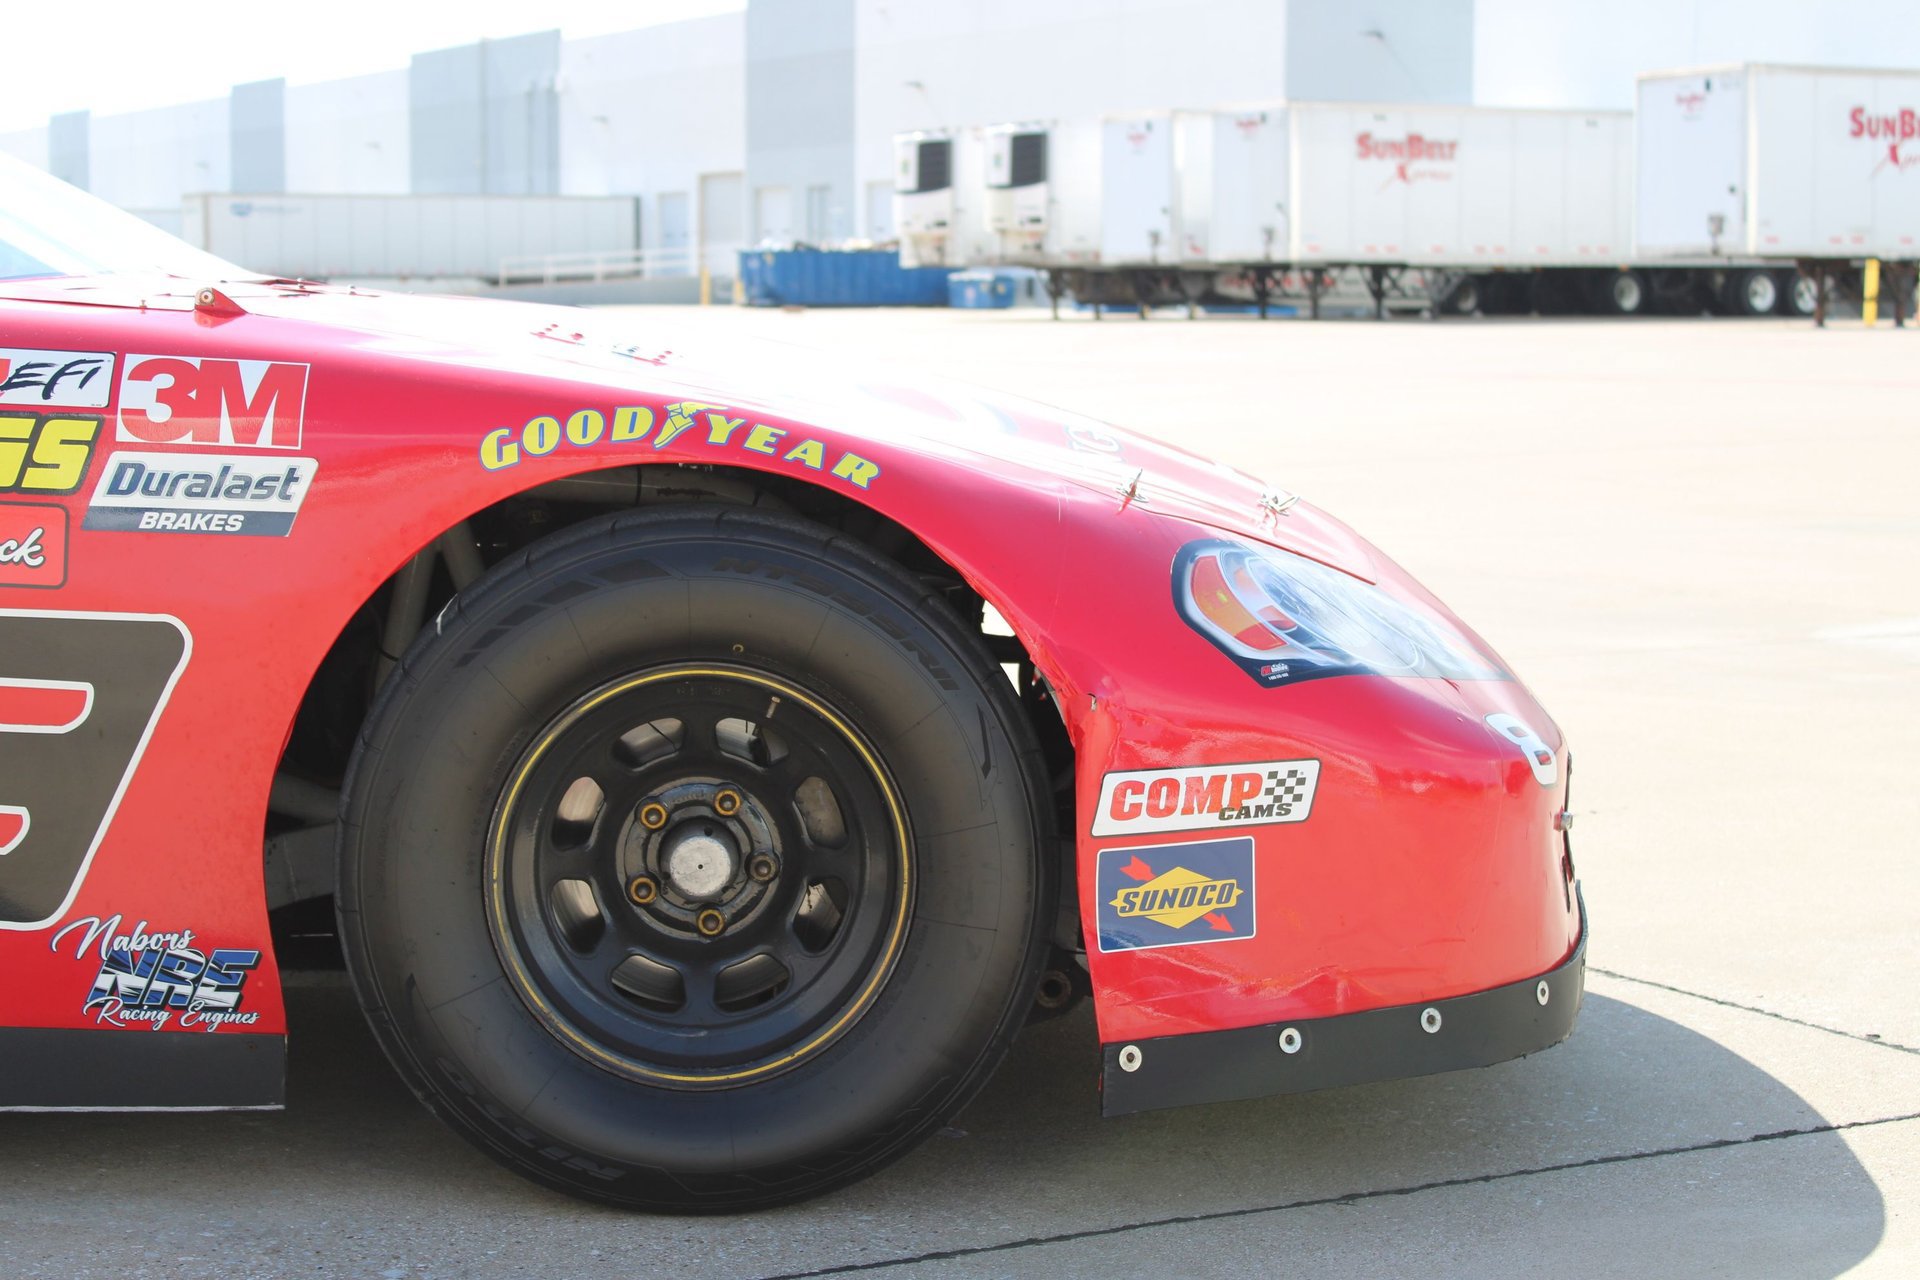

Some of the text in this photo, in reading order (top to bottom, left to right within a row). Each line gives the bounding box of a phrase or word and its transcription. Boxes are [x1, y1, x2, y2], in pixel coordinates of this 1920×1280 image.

[120, 358, 309, 447] 3M
[103, 461, 303, 503] Duralast
[138, 511, 245, 532] BRAKES
[1109, 772, 1263, 821] COMP
[1218, 802, 1293, 821] CAMS
[1118, 882, 1236, 914] SUNOCO
[51, 914, 196, 960] Nabors
[86, 949, 262, 1013] NRE
[83, 996, 260, 1033] Racing Engines
